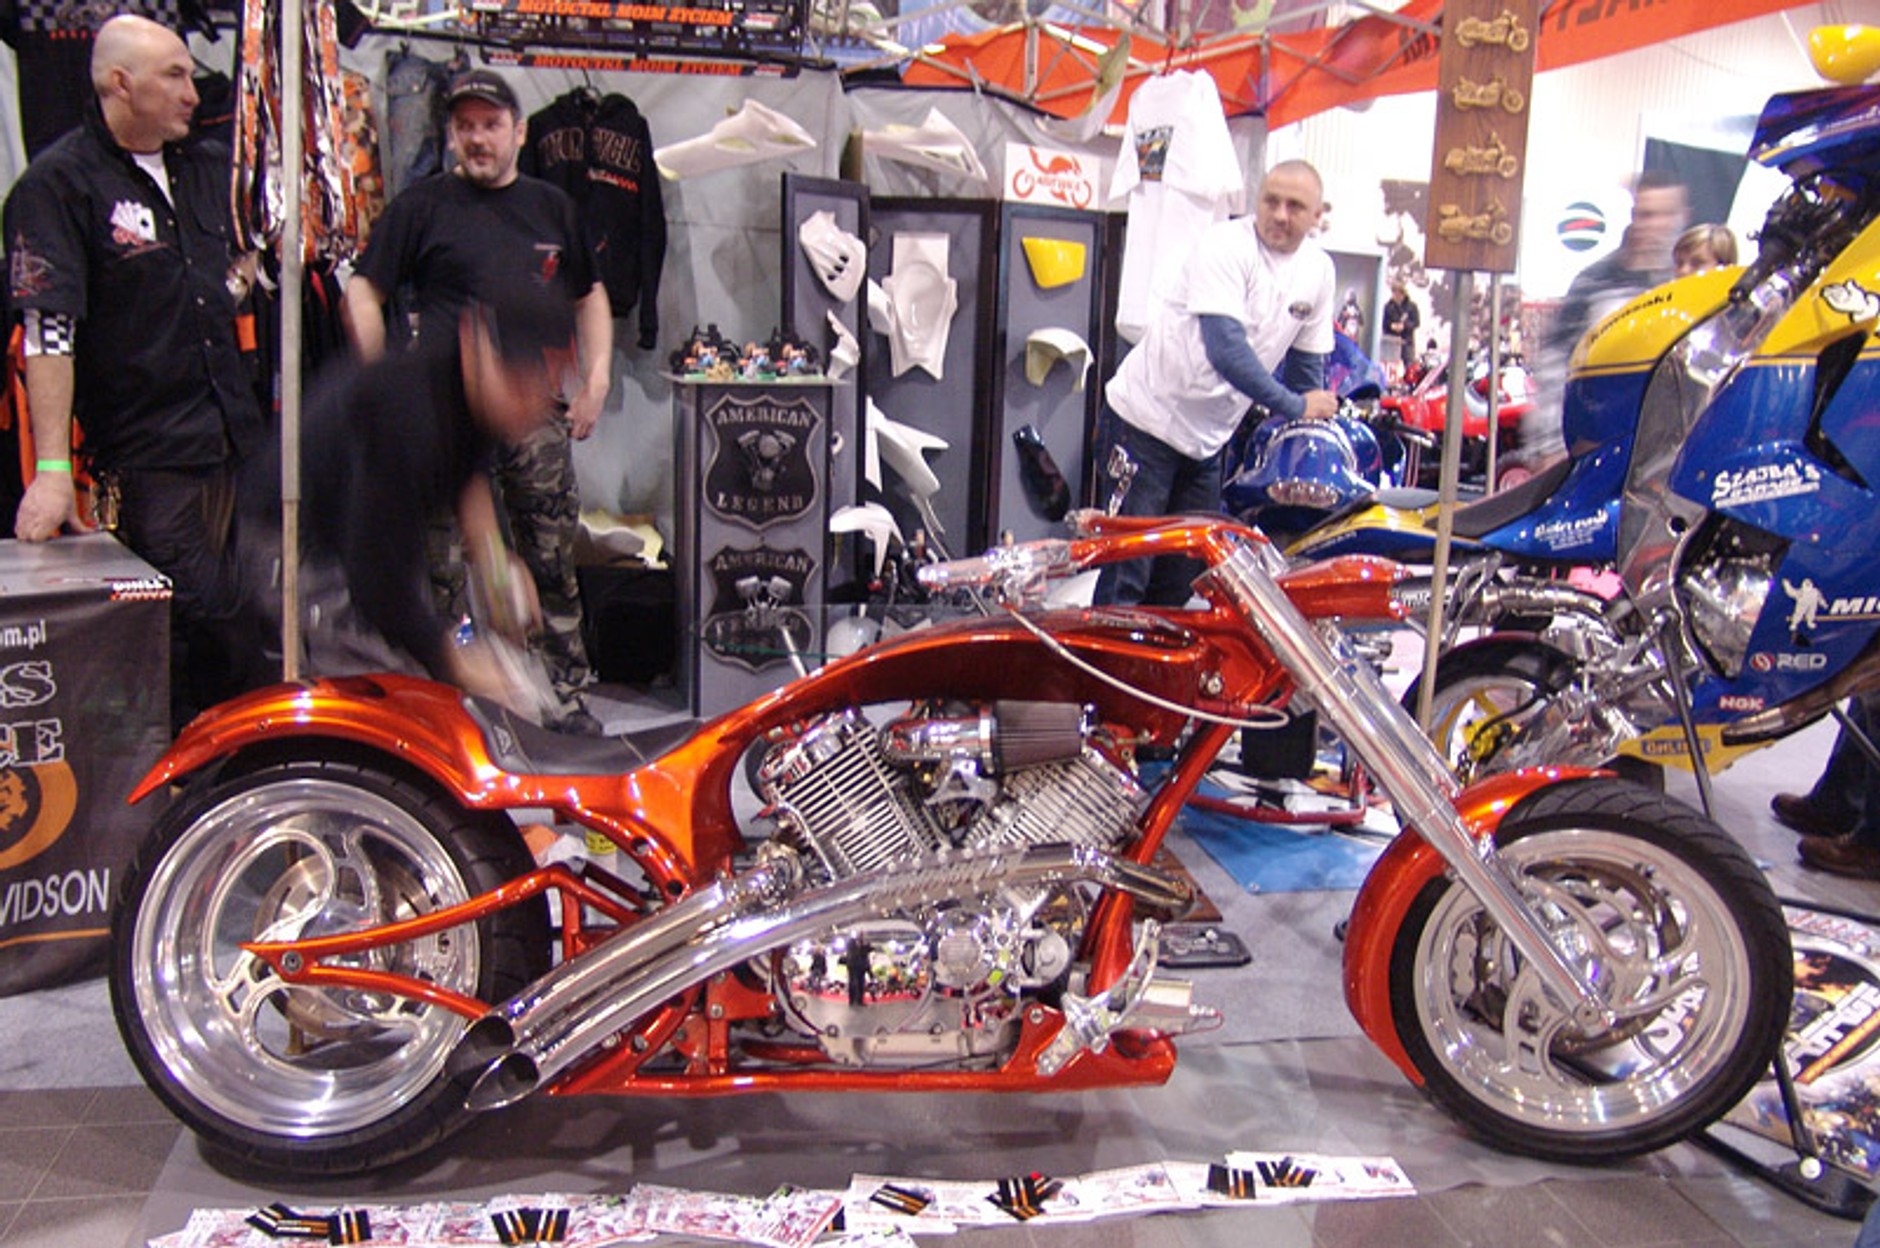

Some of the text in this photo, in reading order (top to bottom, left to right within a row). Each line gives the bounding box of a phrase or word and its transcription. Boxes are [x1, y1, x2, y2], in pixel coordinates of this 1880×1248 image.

[717, 406, 810, 428] AMERICAN
[717, 492, 803, 512] LEGEND
[715, 551, 808, 573] AMERICAN
[1776, 653, 1828, 671] RED
